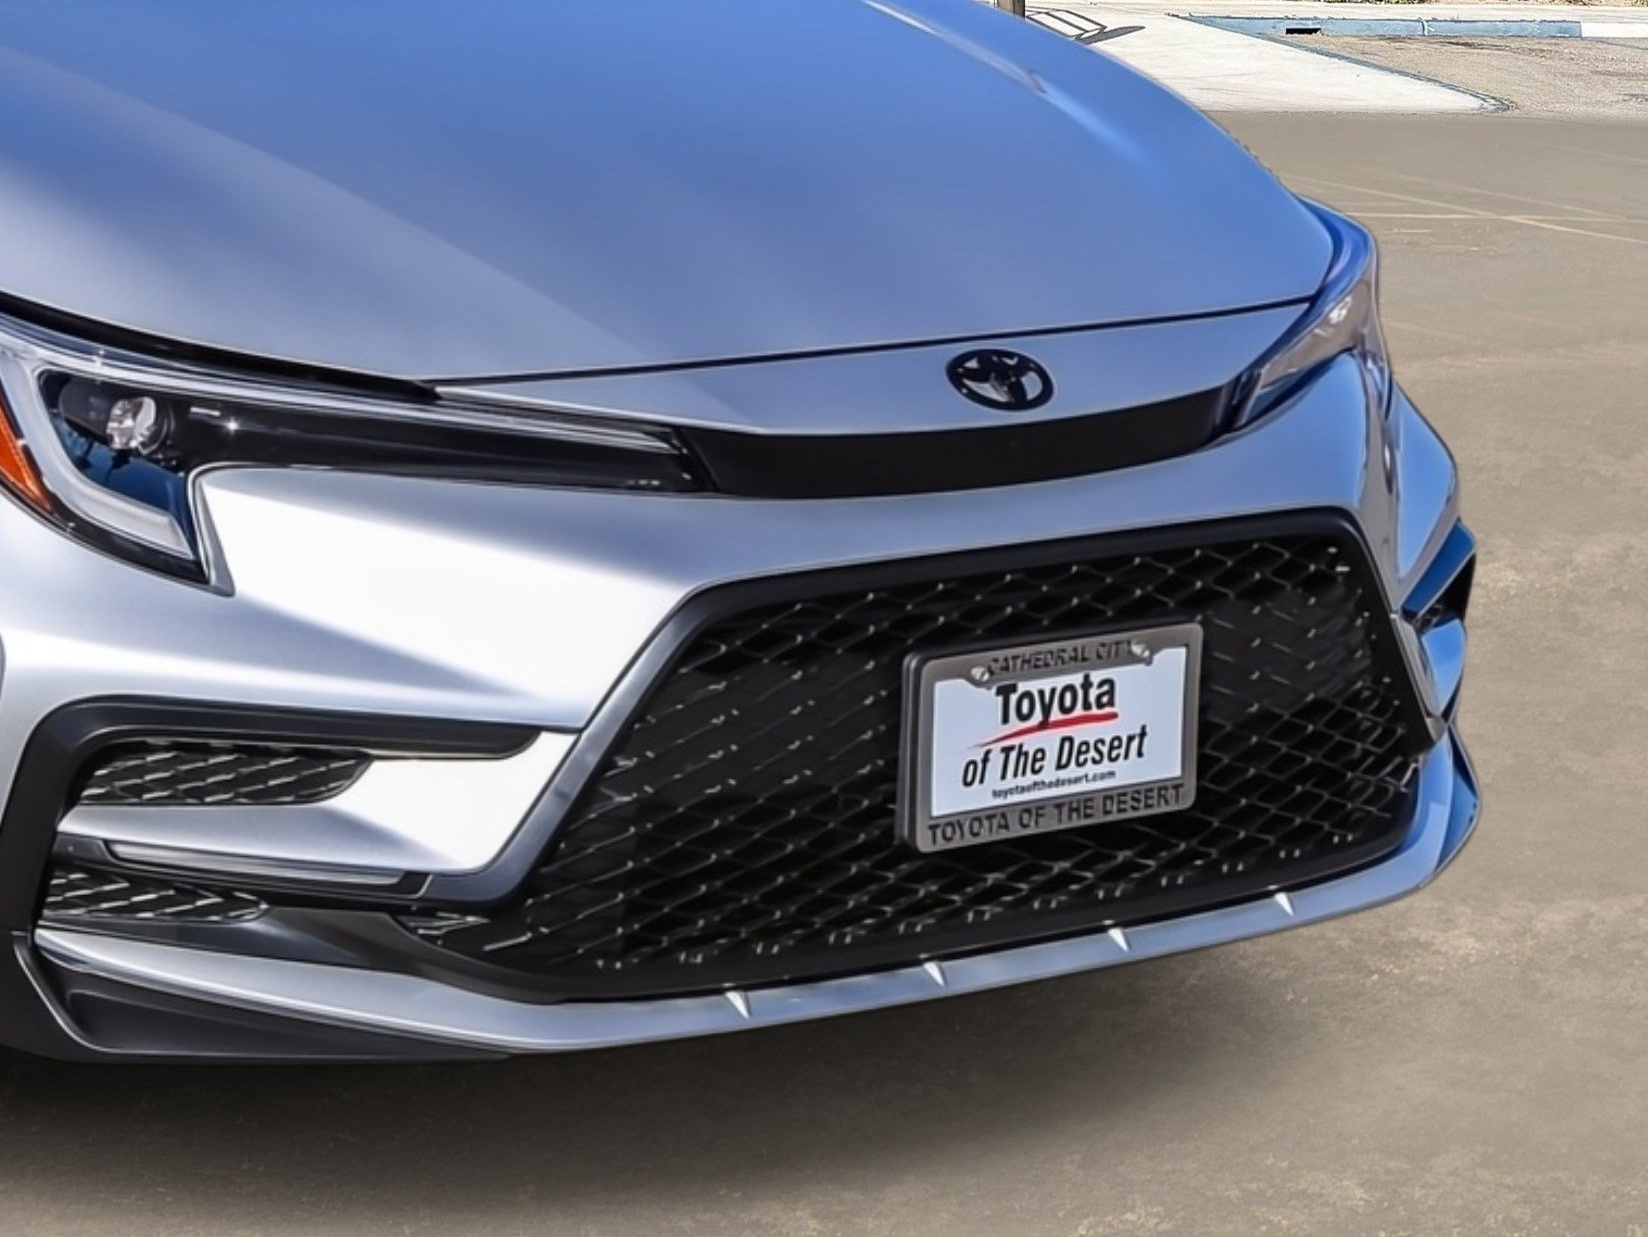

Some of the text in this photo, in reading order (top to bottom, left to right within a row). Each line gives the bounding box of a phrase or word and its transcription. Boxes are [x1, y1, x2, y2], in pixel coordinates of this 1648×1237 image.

[995, 672, 1116, 729] Toyota
[962, 724, 1148, 787] of The Desert
[992, 769, 1116, 800] toyotaofthedesert.com
[928, 783, 1185, 846] TOYOTA OF THE DESERT
